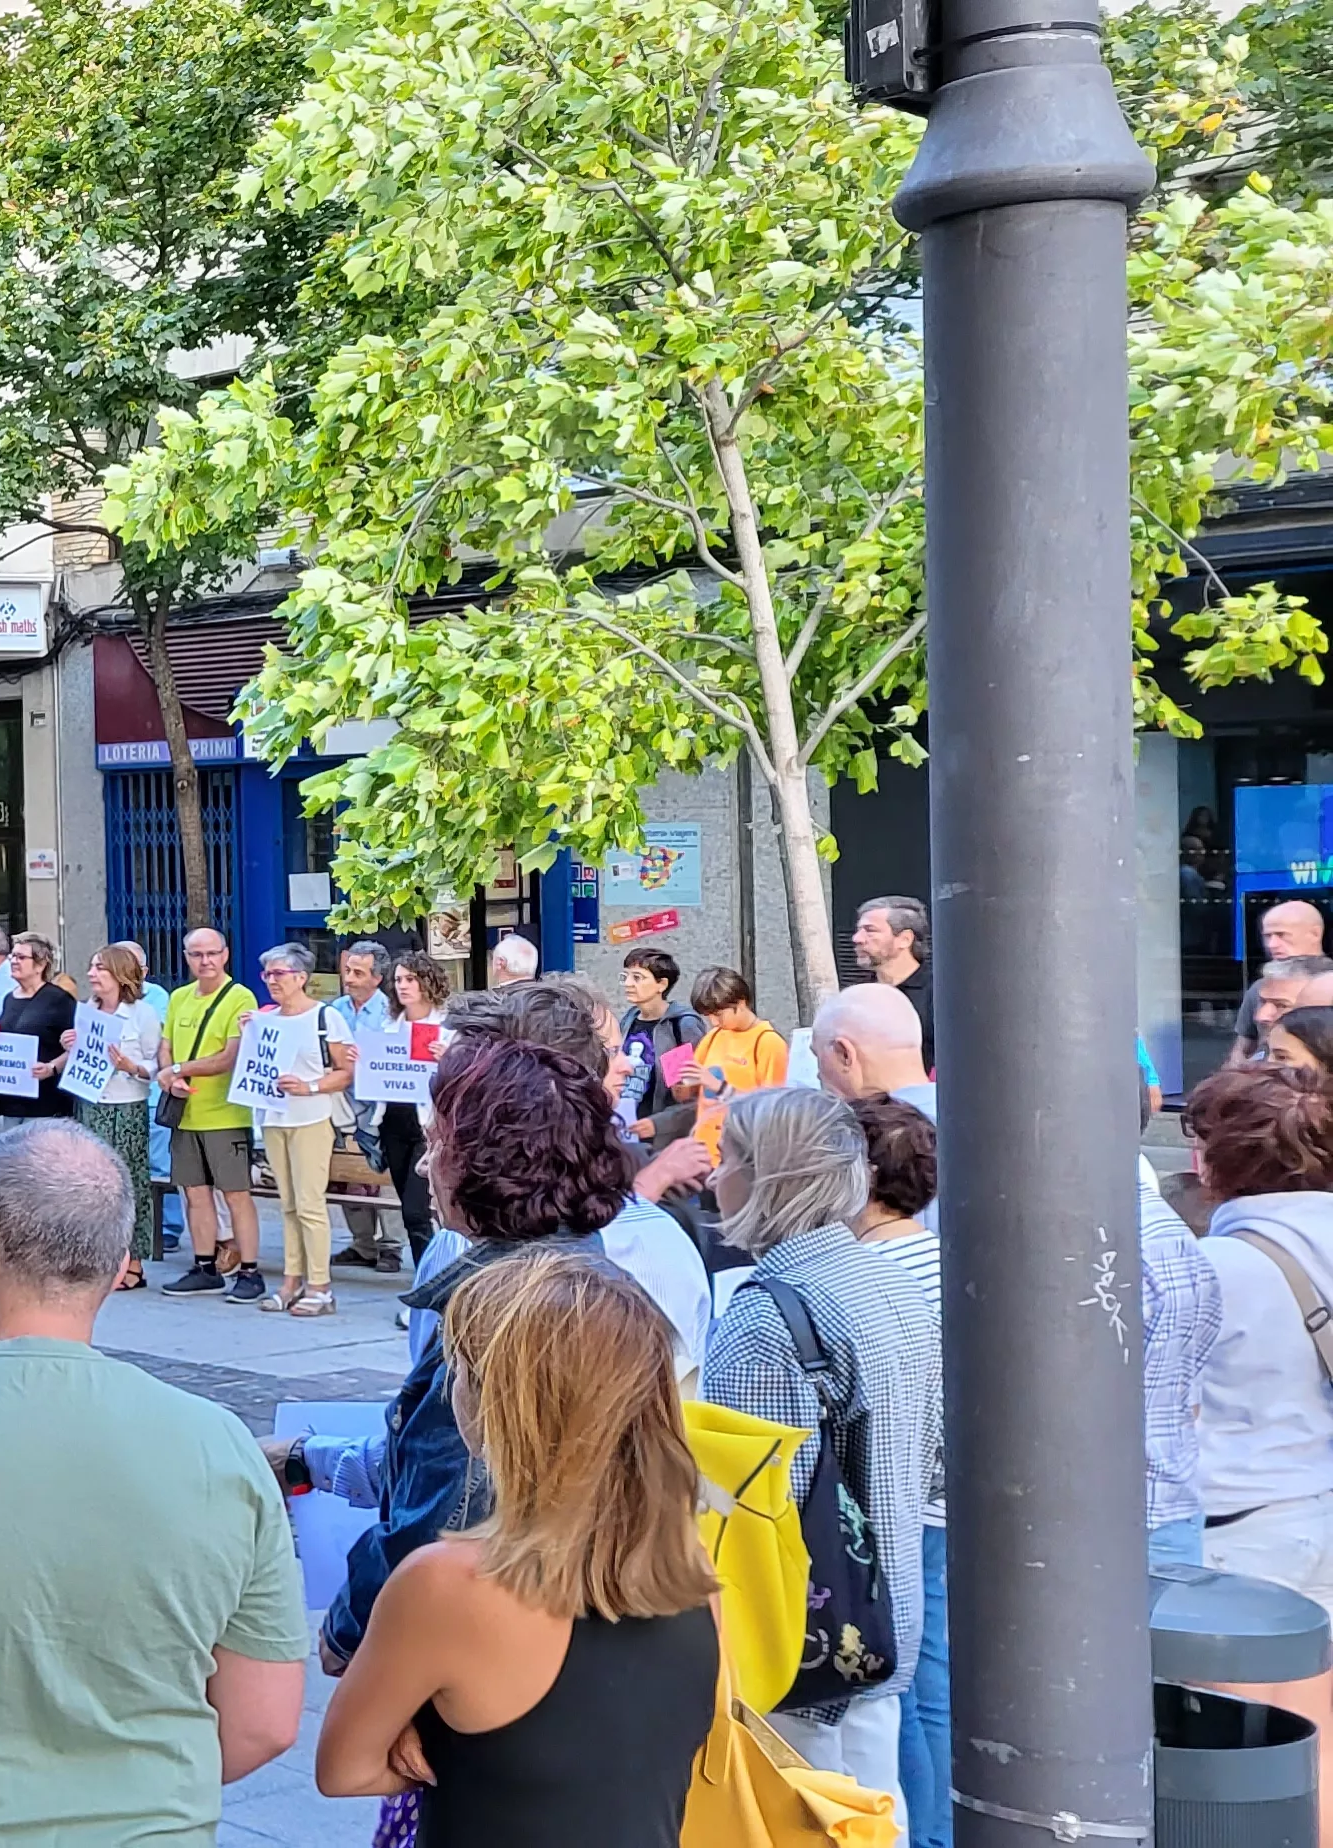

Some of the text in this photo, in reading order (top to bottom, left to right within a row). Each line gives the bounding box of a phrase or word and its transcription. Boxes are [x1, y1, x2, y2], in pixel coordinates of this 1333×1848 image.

[11, 620, 37, 634] maths
[105, 746, 160, 761] LOTERIA
[192, 741, 232, 758] PRIMI
[90, 1020, 105, 1037] NI
[261, 1026, 280, 1042] NI
[86, 1037, 105, 1055] UN
[257, 1044, 278, 1062] UN
[385, 1045, 408, 1055] NOS
[76, 1049, 109, 1073] PASO
[369, 1061, 427, 1073] QUEREMOS
[66, 1066, 106, 1091] ATRÁS
[245, 1060, 280, 1081] PASO
[236, 1078, 286, 1099] ATRÁS
[383, 1080, 416, 1091] VIVAS
